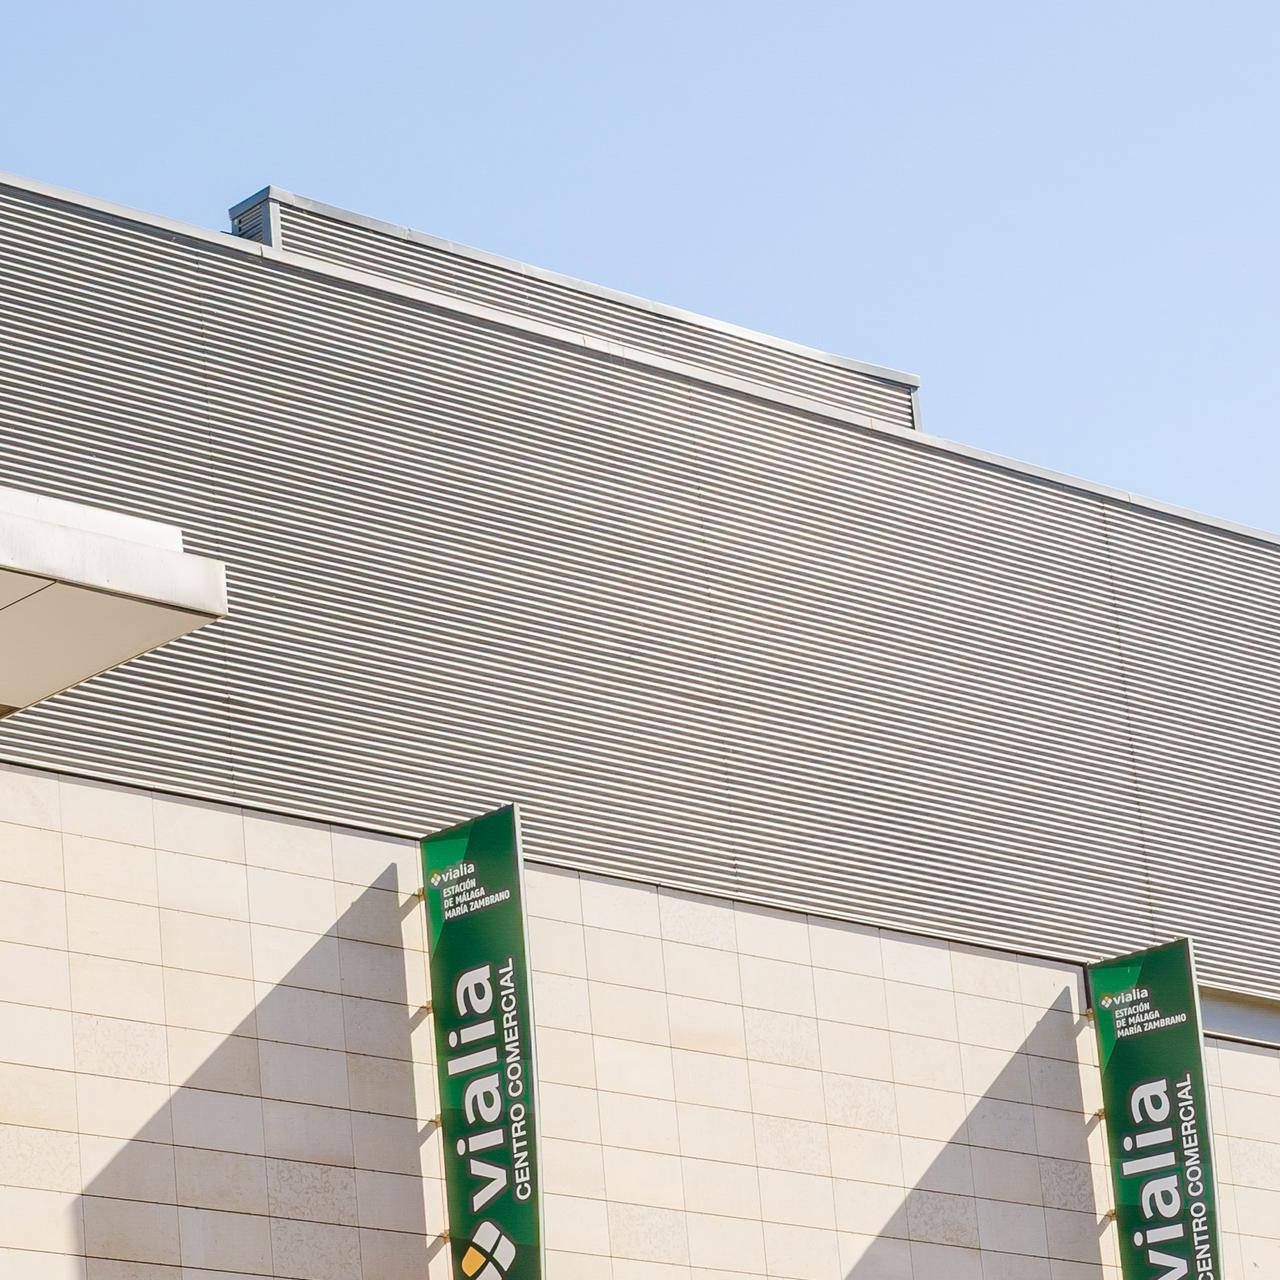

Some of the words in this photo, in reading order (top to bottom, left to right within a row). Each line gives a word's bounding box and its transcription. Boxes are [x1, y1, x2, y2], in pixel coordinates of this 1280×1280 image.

[441, 863, 475, 882] vialia
[442, 878, 476, 898] ESTACIÓN
[443, 898, 454, 909] DE
[455, 887, 486, 905] MÁLAGA
[444, 904, 469, 920] MARÍA
[469, 889, 511, 912] ZAMBRANO
[1113, 988, 1149, 1005] vialia
[1114, 1002, 1150, 1019] ESTACIÓN
[1115, 1019, 1127, 1029] DE
[1128, 1010, 1160, 1026] MÁLAGA
[498, 956, 524, 1098] COMERCIAL
[1116, 1024, 1143, 1039] MARÍA
[1143, 1013, 1187, 1032] ZAMBRANO
[447, 963, 508, 1213] vialia
[1175, 1072, 1204, 1198] COMERCIAL
[509, 1103, 532, 1201] CENTRO
